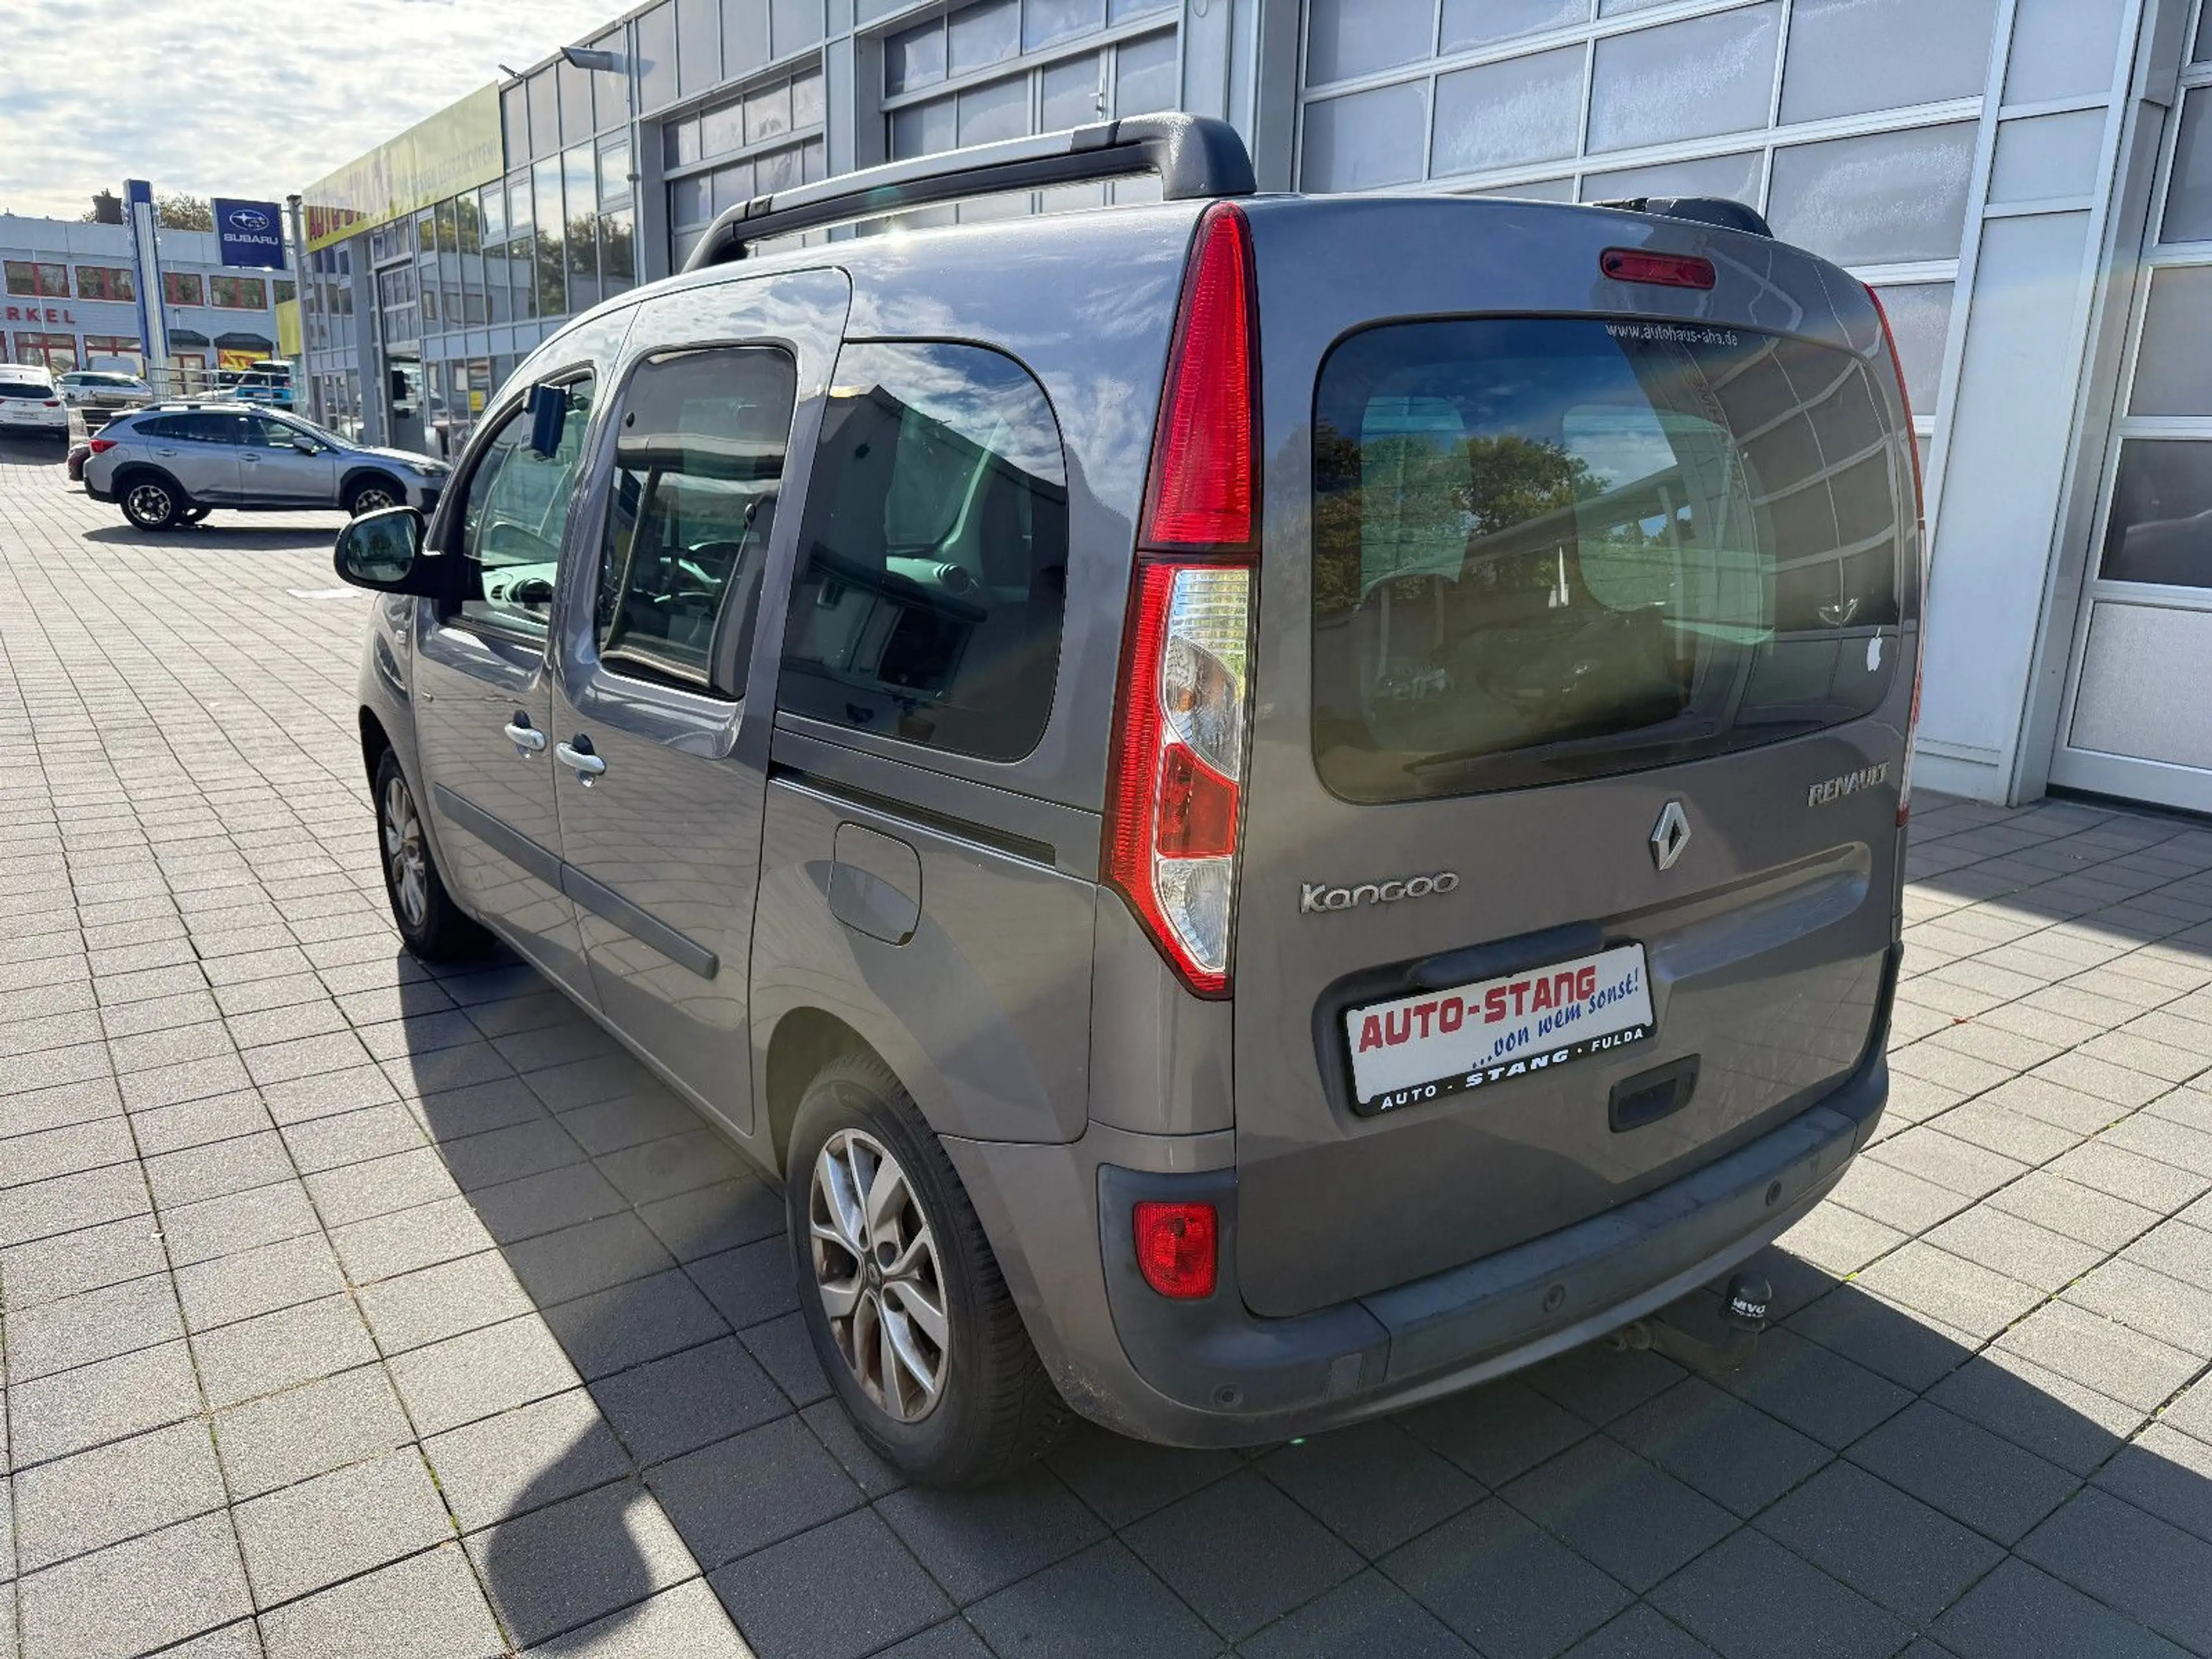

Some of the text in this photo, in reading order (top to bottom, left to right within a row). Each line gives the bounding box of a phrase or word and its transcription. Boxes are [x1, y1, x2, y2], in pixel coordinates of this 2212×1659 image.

[224, 233, 279, 246] SUBARU
[1808, 760, 1891, 807] RENAULT
[1300, 872, 1460, 914] Kangoo
[1358, 964, 1596, 1053] AUTO-STANG
[1538, 1002, 1582, 1039] wem
[1588, 967, 1639, 1013] sonst!
[1381, 1027, 1643, 1110] AUTO STANG FULDA
